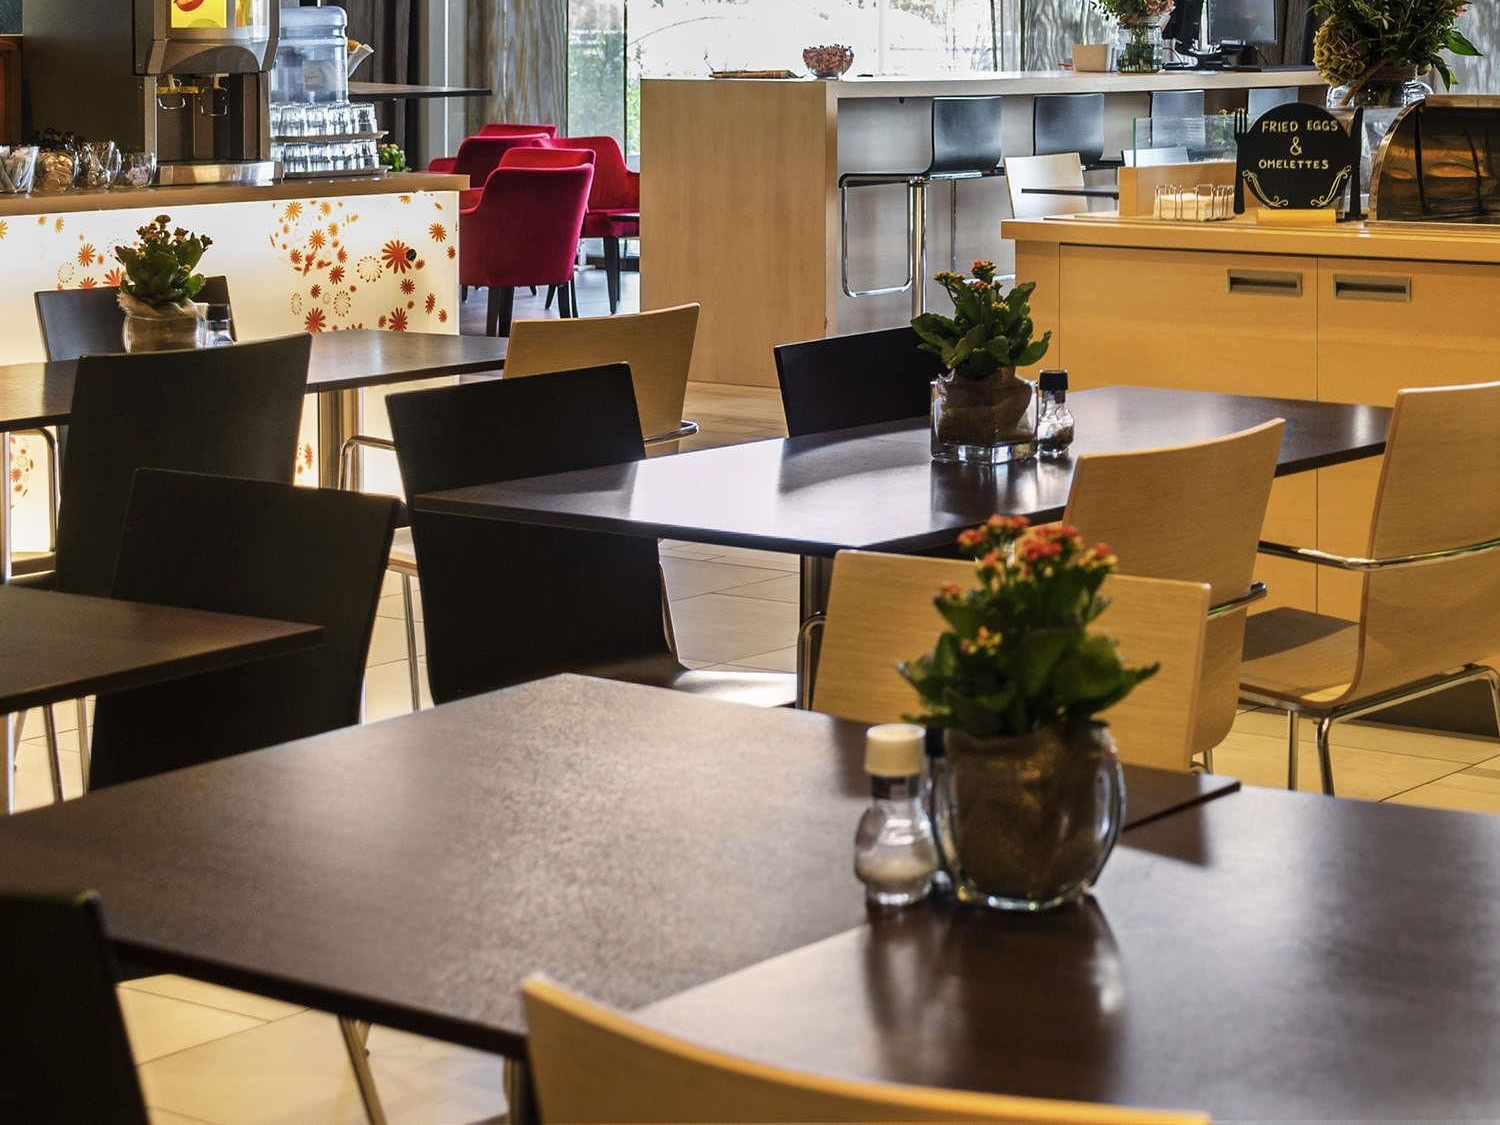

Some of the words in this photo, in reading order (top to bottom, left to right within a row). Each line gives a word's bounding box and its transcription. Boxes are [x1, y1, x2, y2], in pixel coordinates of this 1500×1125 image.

[1262, 120, 1299, 133] FRIED
[1307, 119, 1338, 132] EGGS
[1290, 136, 1303, 156] &
[1258, 159, 1329, 170] OMELETTES
